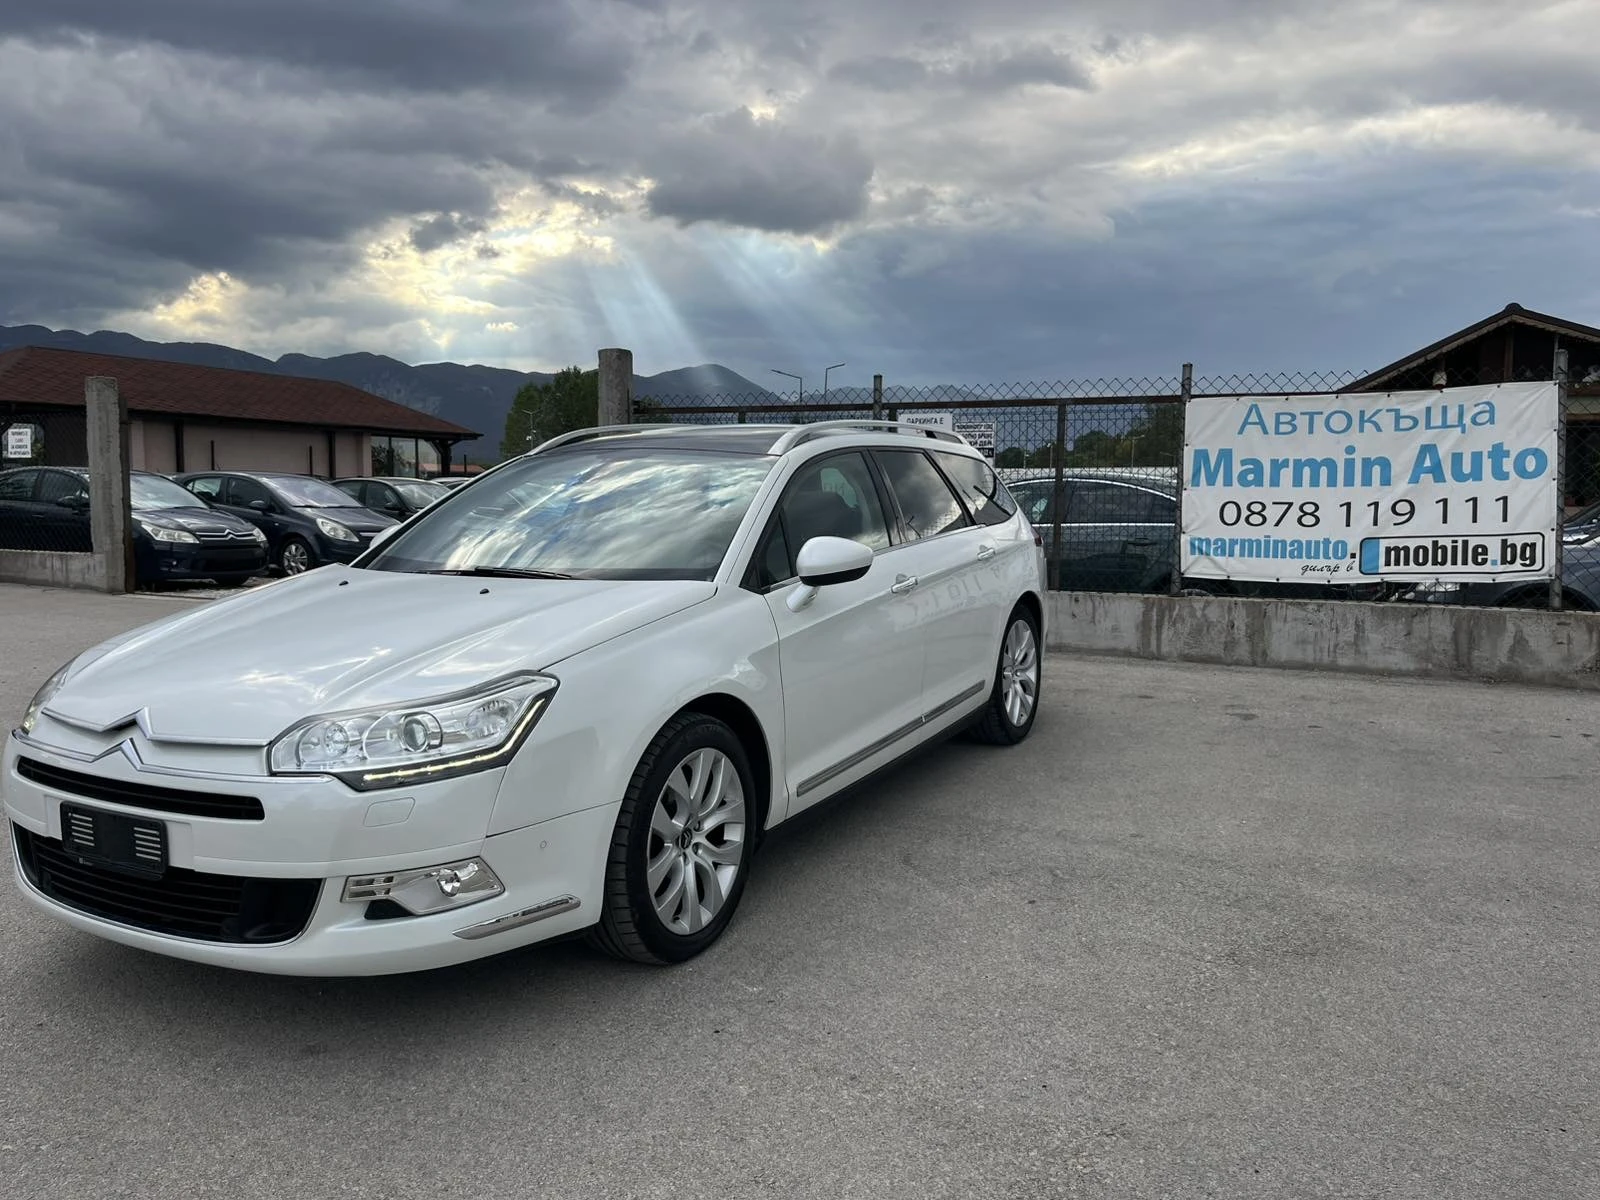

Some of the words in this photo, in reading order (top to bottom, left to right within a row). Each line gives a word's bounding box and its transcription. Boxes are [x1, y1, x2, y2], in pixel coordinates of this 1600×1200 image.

[1190, 445, 1392, 488] Marmin
[1408, 442, 1549, 484] Auto
[1219, 500, 1321, 528] 0878
[1339, 499, 1416, 528] 119
[1435, 496, 1509, 525] 111
[1384, 538, 1538, 568] mobile.bg
